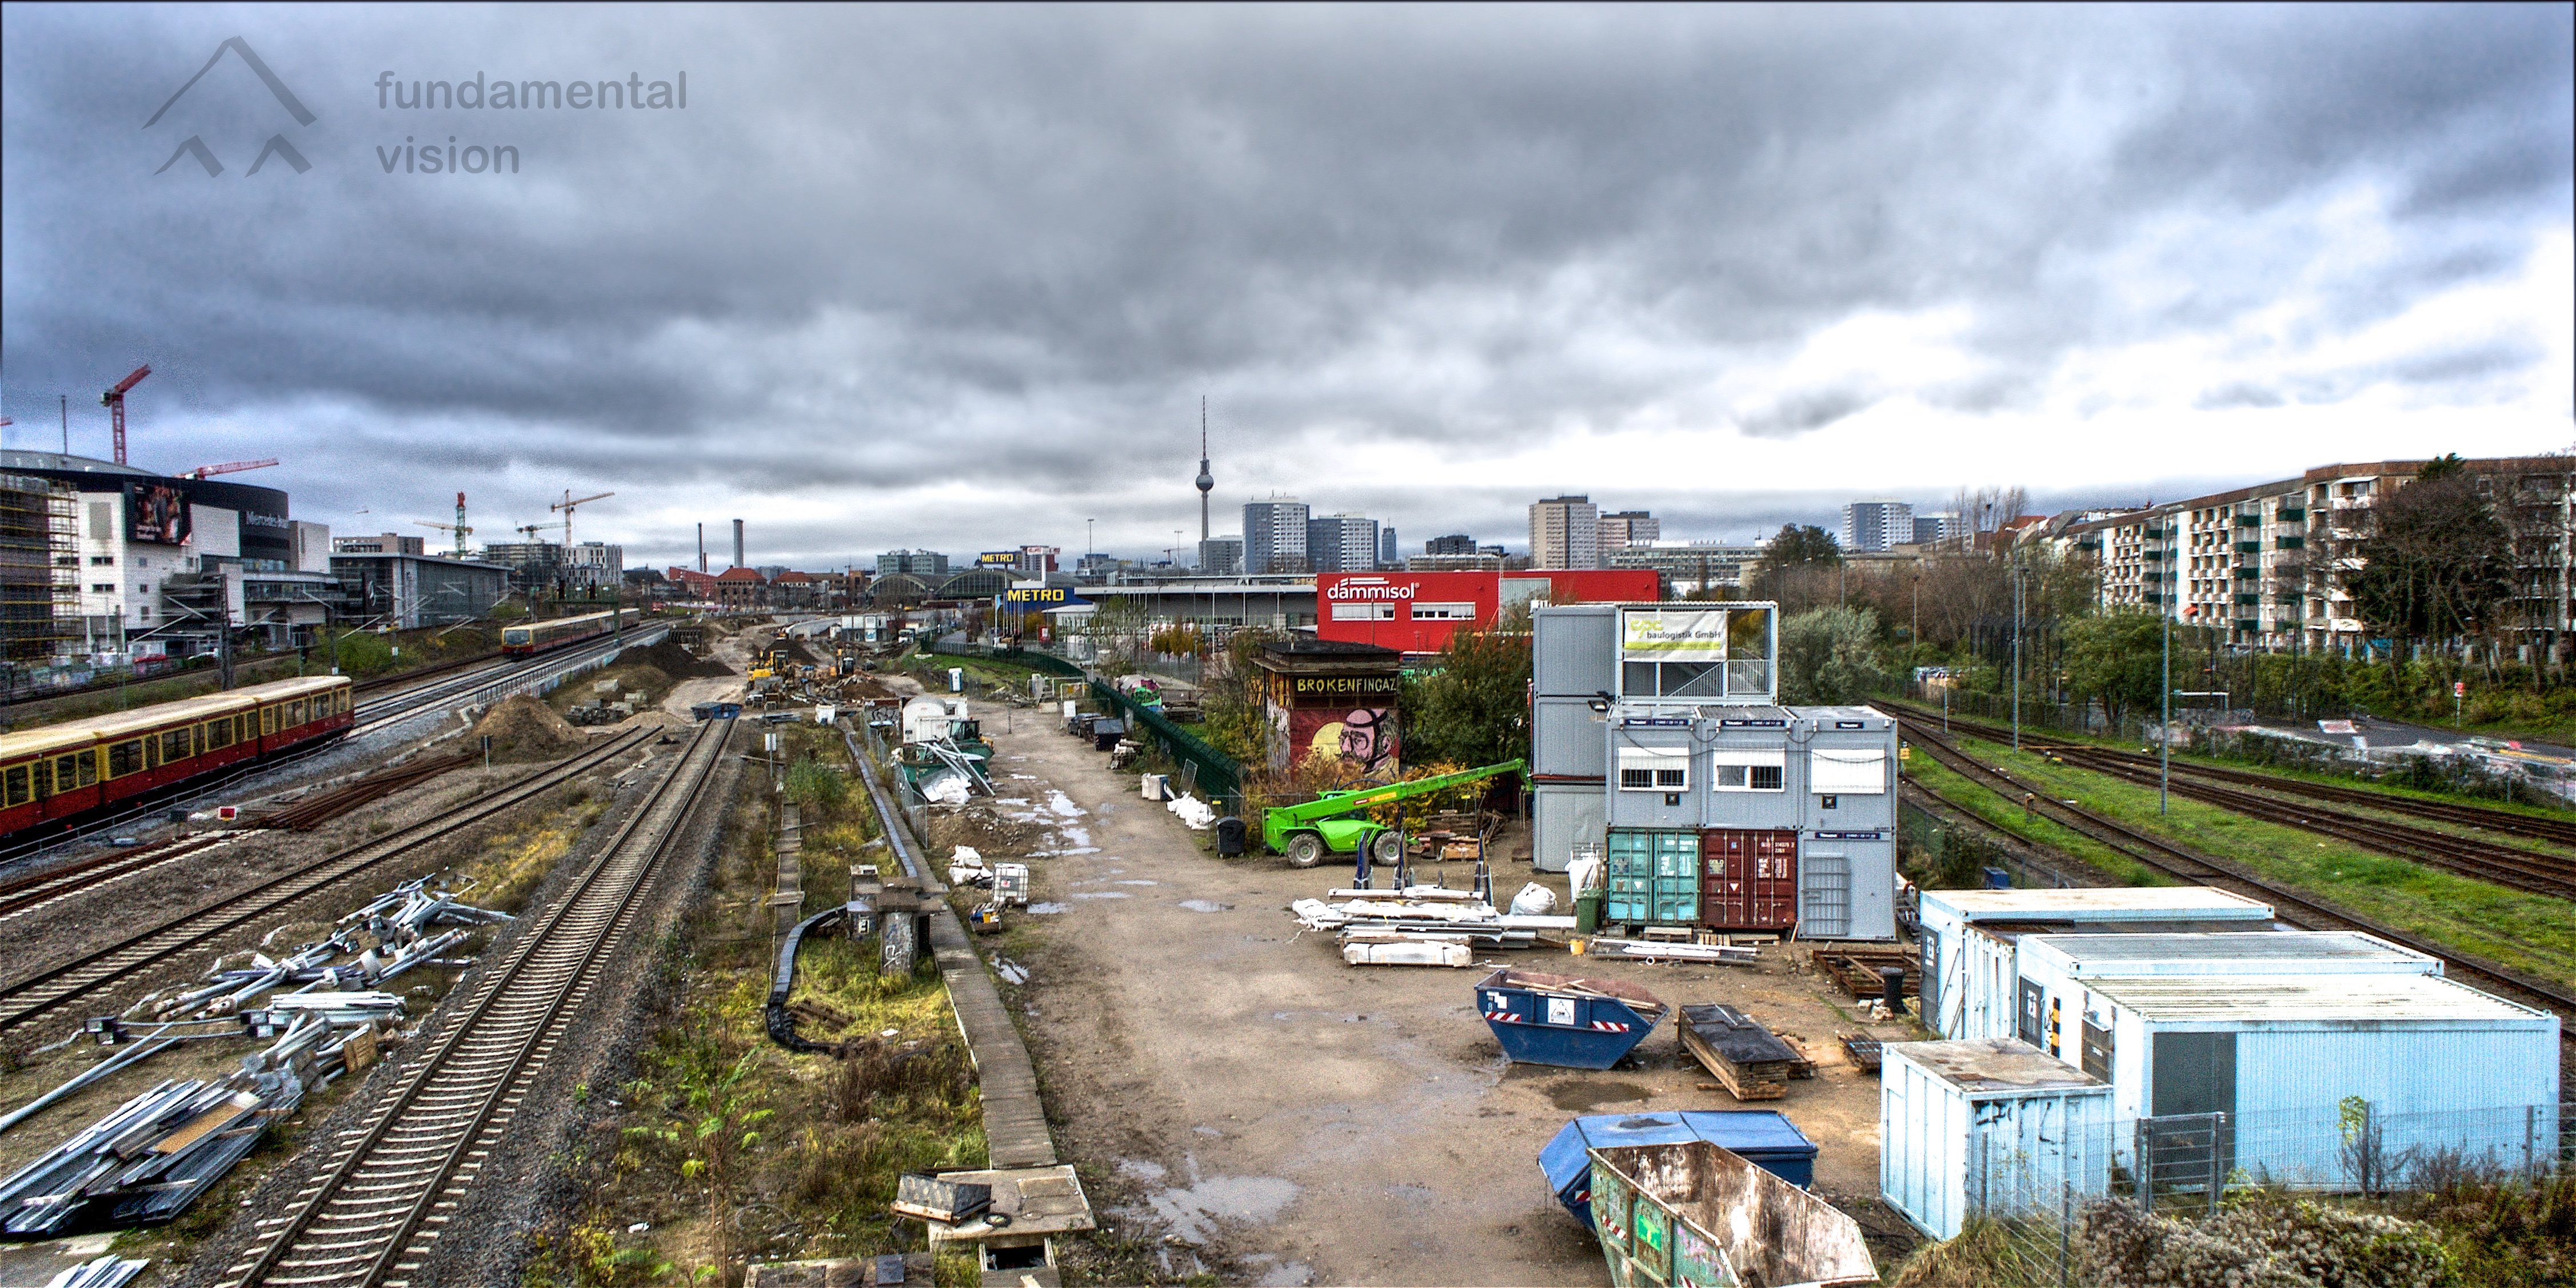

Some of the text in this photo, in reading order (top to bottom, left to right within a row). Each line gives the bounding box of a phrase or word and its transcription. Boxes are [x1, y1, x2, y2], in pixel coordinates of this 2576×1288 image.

[981, 553, 1013, 563] METRO
[1007, 589, 1064, 601] METRO
[1647, 631, 1721, 640] baulogistik GmbH
